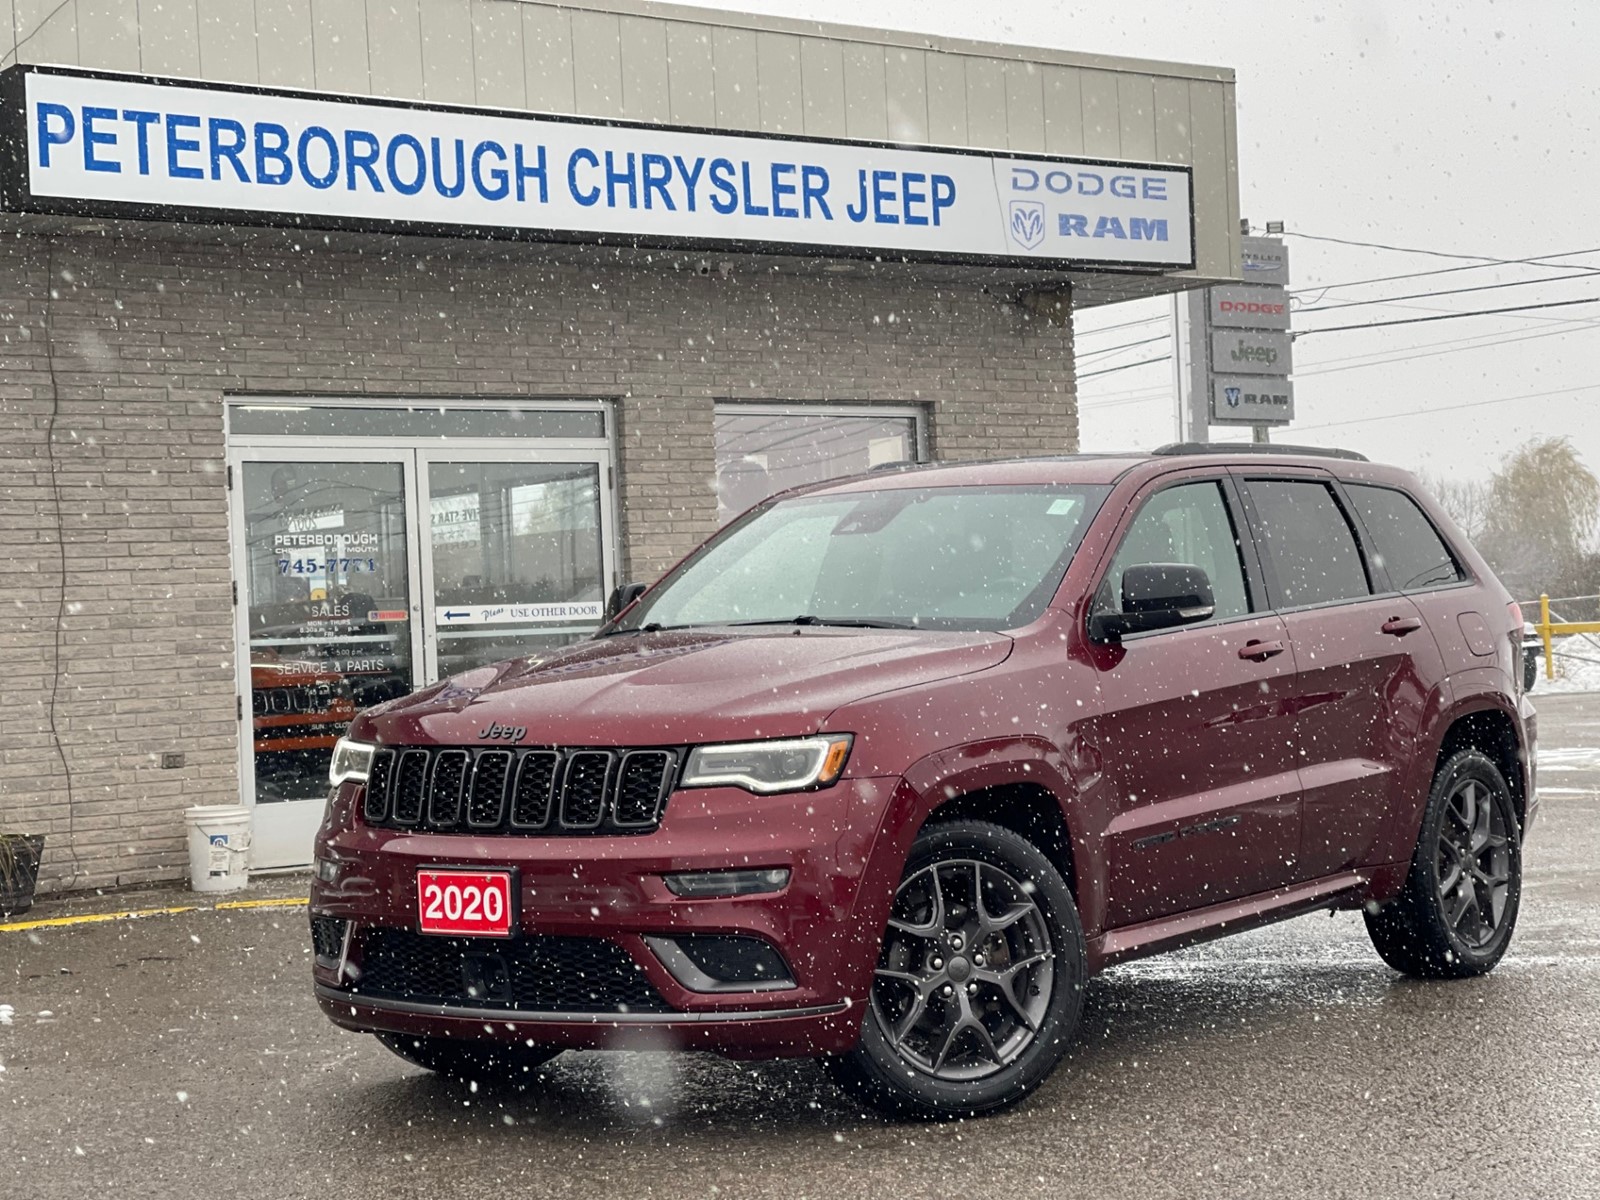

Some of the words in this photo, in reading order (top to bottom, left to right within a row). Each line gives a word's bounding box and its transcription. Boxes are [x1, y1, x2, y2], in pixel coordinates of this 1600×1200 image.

[36, 101, 549, 204] PETERBOROUGH
[567, 147, 834, 221] CHRYSLER
[846, 169, 956, 227] JEEP
[1011, 167, 1168, 201] DODGE
[1057, 212, 1169, 242] RAM
[1241, 253, 1282, 262] YSLER
[1219, 300, 1285, 315] DODGE
[1230, 339, 1278, 367] Jeep
[1243, 393, 1288, 406] RAM
[274, 534, 378, 546] PETERBOROUGH
[311, 605, 350, 617] SALES
[480, 608, 505, 621] Pleas
[510, 608, 530, 617] USE
[532, 606, 567, 616] OTHER
[569, 606, 598, 615] DOOR
[277, 661, 328, 675] SERVICE
[347, 659, 384, 672] PARTS
[478, 721, 527, 742] Jeep
[424, 884, 503, 922] 2020
